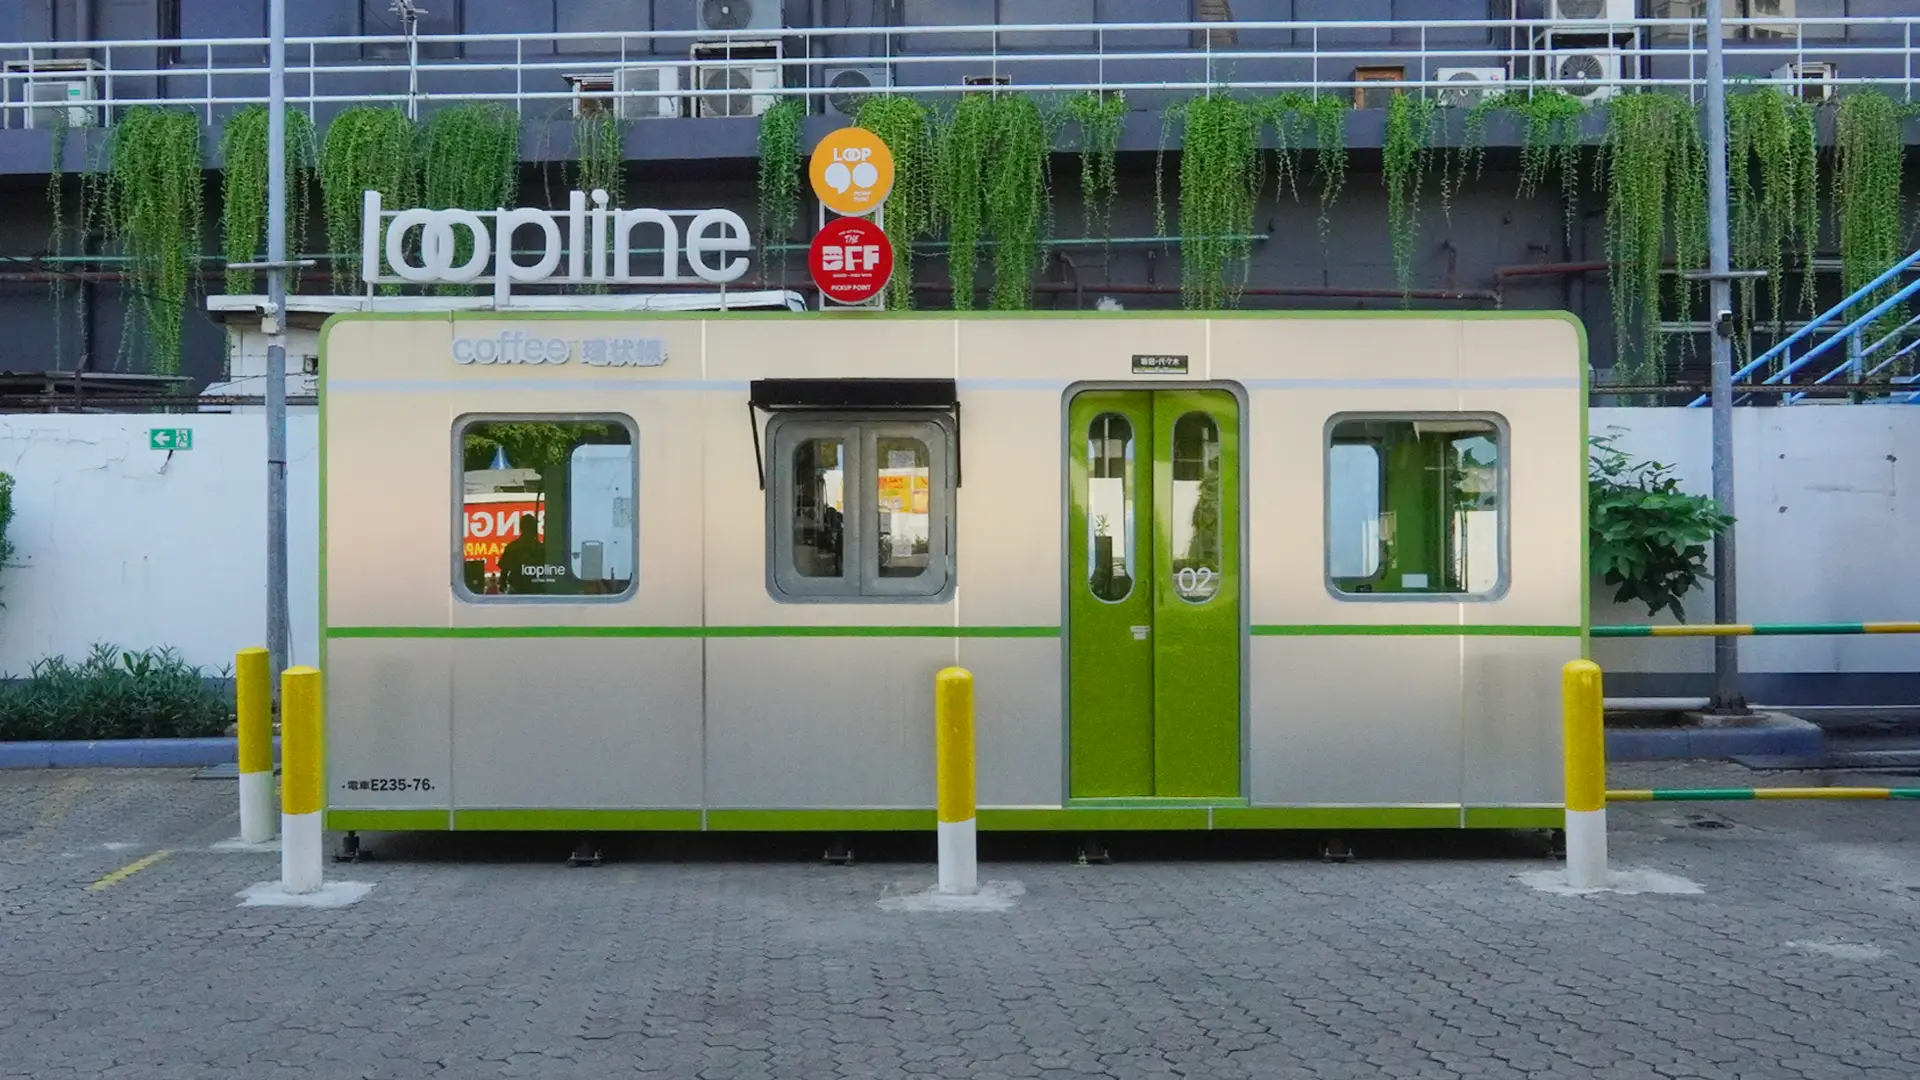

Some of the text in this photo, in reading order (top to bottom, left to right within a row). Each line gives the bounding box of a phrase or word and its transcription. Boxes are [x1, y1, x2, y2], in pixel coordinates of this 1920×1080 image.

[833, 147, 872, 161] LOOP
[361, 188, 751, 305] loopline
[822, 245, 880, 271] BFF
[452, 331, 570, 364] coffee
[521, 564, 566, 578] loopline
[1178, 567, 1213, 592] 02
